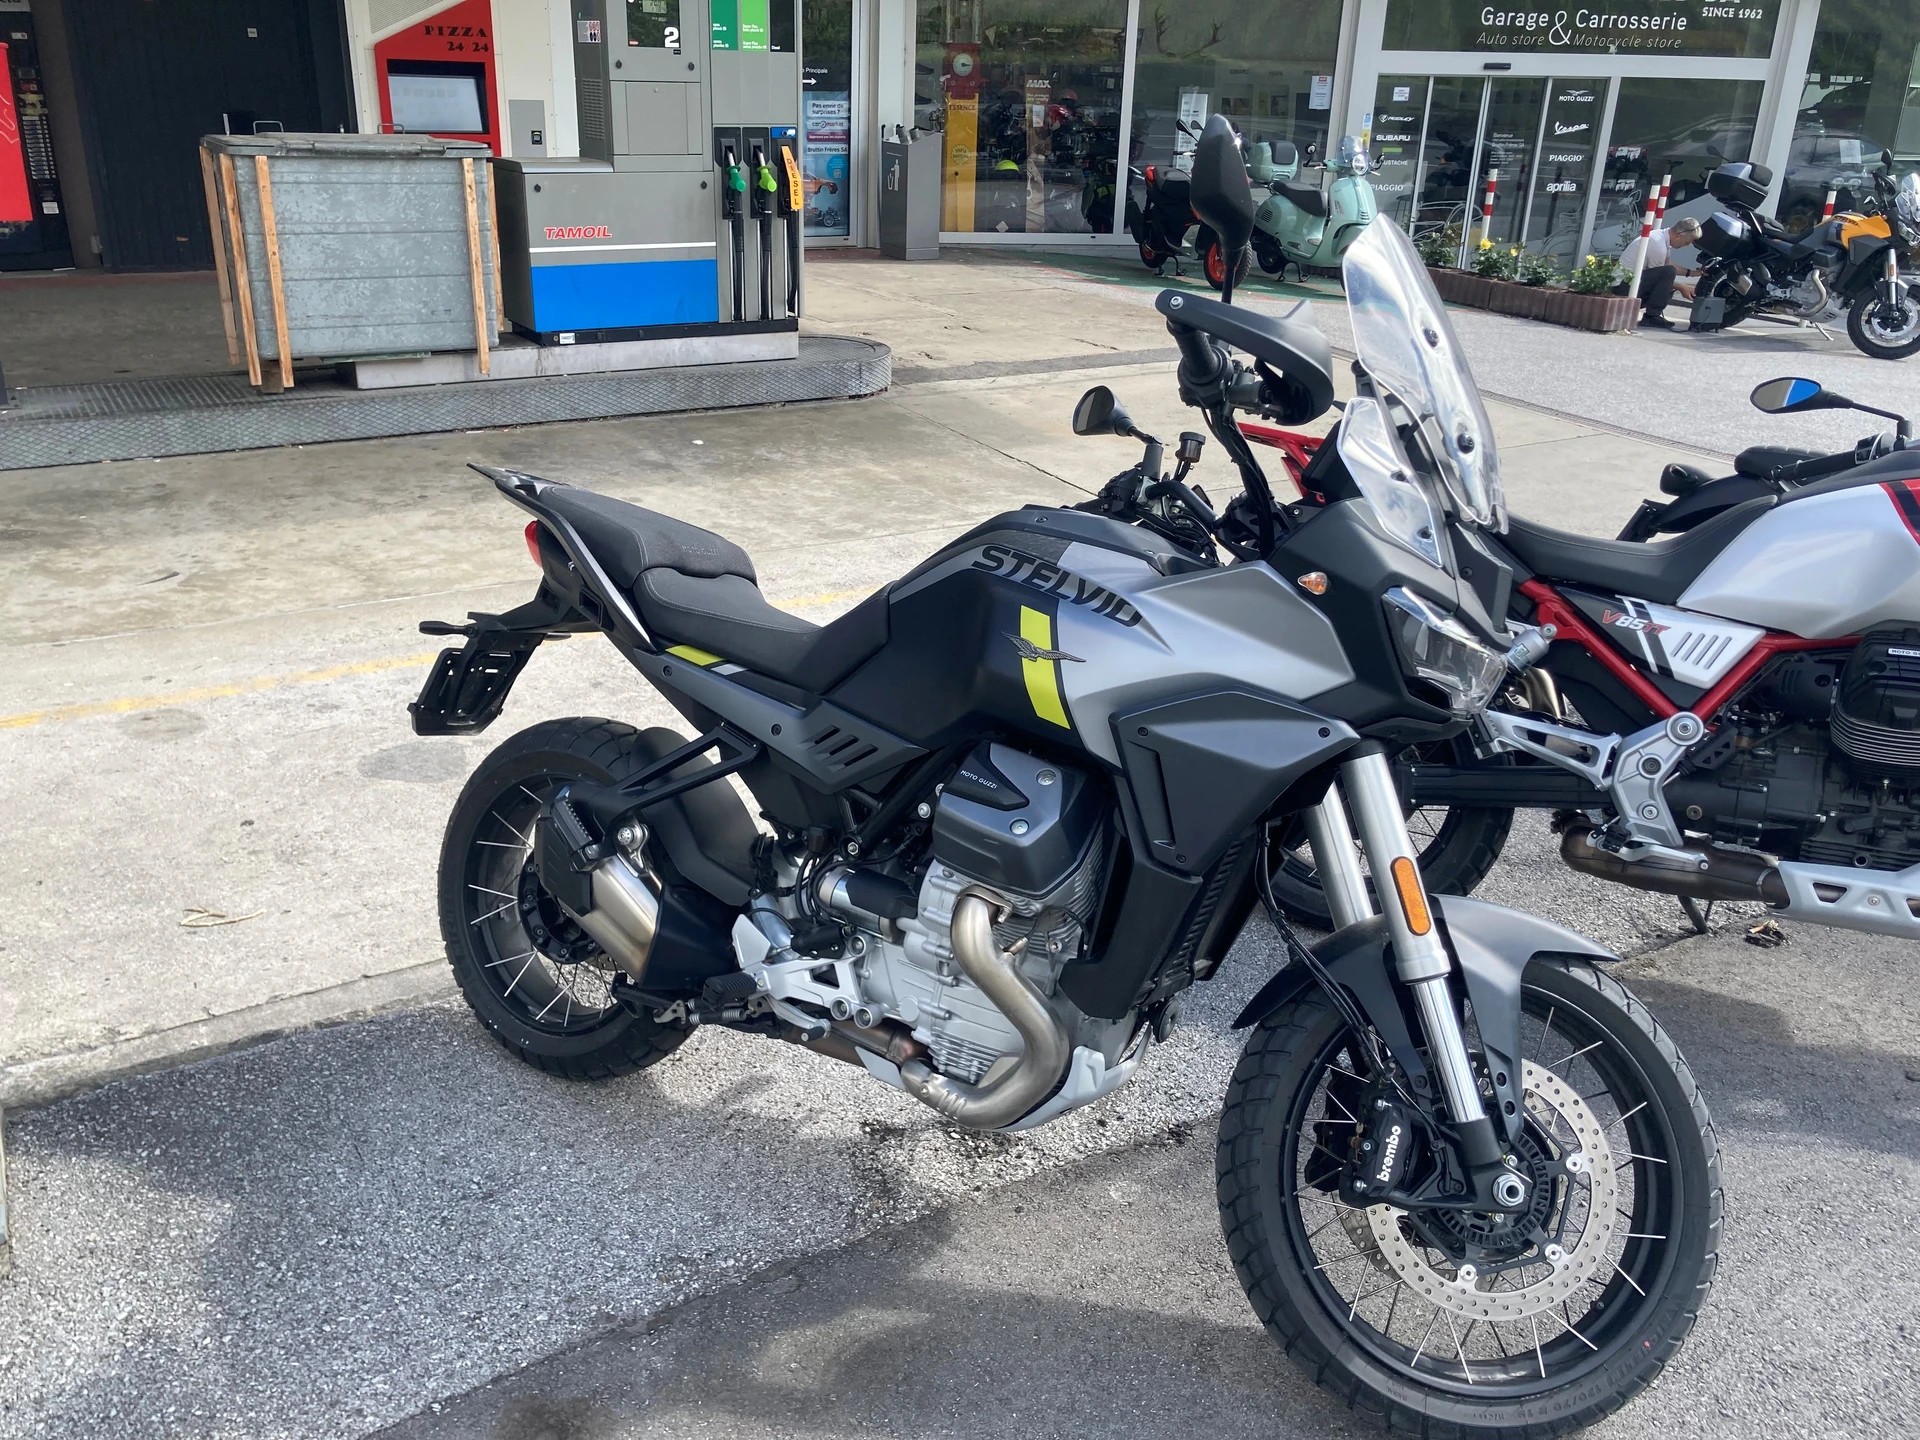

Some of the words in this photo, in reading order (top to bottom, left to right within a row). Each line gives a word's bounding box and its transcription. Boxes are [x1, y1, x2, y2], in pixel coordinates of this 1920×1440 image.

[1702, 6, 1739, 18] SINCE
[1738, 8, 1763, 19] 1962
[424, 25, 488, 37] PIZZA
[1481, 6, 1549, 31] Garage
[1548, 10, 1572, 45] &
[1576, 9, 1687, 31] Carrosserie
[664, 26, 680, 48] 2
[1476, 32, 1507, 45] Auto
[1511, 33, 1545, 46] store
[1573, 33, 1642, 48] Motocycle
[1646, 36, 1682, 49] store
[446, 41, 464, 51] 24
[472, 42, 489, 52] 24
[1026, 79, 1052, 89] MAX
[1554, 121, 1589, 135] Vespa
[1549, 154, 1583, 162] PIAGGIO
[787, 158, 799, 205] DIESEL
[1370, 183, 1404, 192] PIAGGIO
[1546, 180, 1577, 193] aprilia
[544, 225, 612, 240] TAMOIL
[971, 545, 1143, 628] STELVIO
[960, 769, 979, 781] MOTO
[978, 777, 998, 789] GUZZI
[1376, 1125, 1402, 1182] brembo
